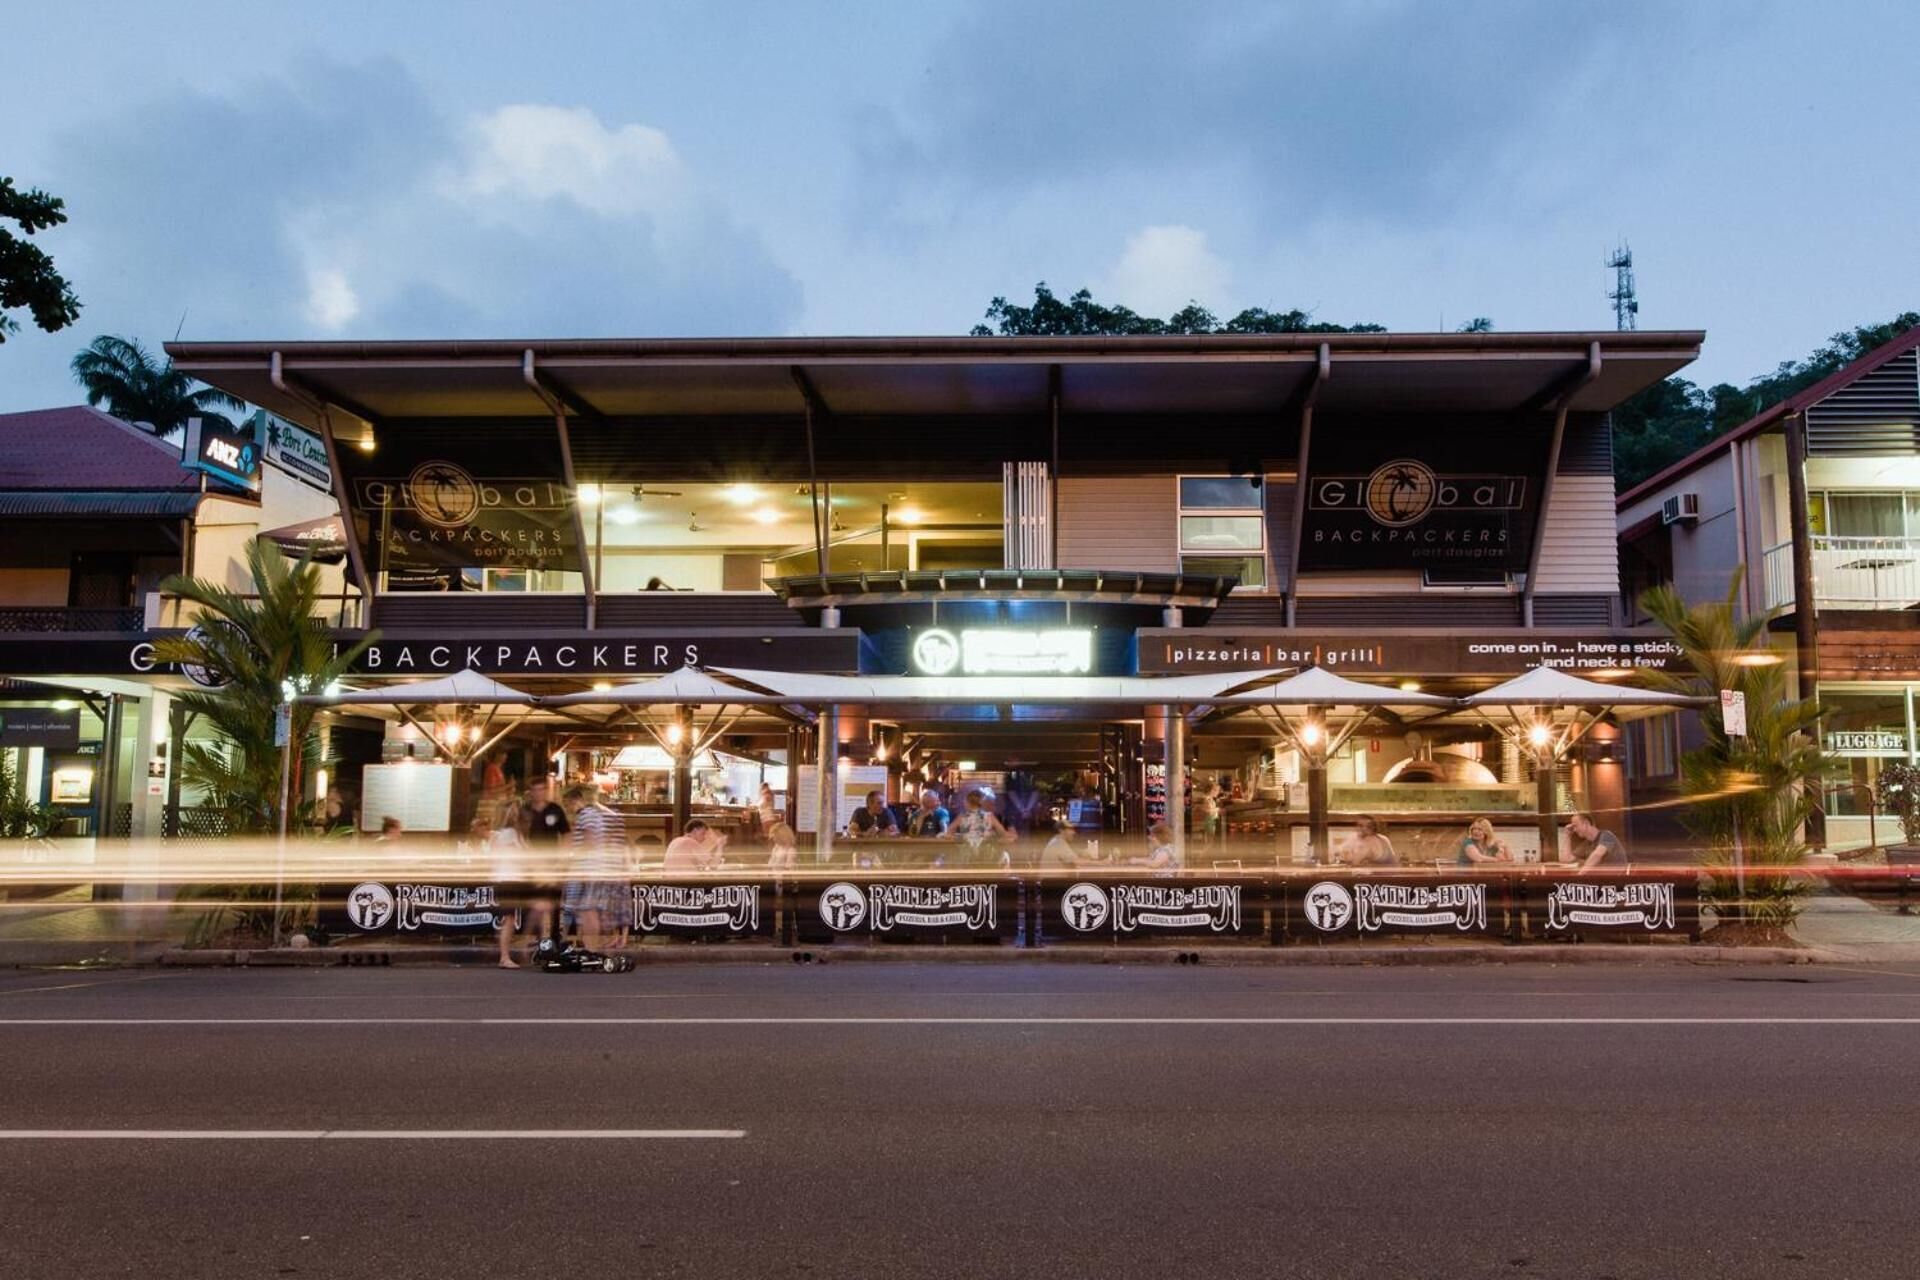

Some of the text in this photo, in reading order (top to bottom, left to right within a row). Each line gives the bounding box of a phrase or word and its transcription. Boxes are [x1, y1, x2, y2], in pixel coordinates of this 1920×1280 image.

[206, 438, 239, 469] ANZ
[374, 528, 562, 543] BACKPACKERS
[1315, 529, 1509, 542] BACKPACKERS
[367, 644, 699, 668] BACKPACKERS
[1174, 648, 1374, 665] pizzeria bar grill
[1469, 643, 1516, 654] come
[1518, 643, 1540, 654] on
[1542, 641, 1557, 653] in
[1577, 641, 1617, 654] have
[1620, 643, 1631, 653] a
[1633, 641, 1685, 656] sticky
[1577, 656, 1617, 668] neck
[1620, 659, 1631, 668] a
[1634, 656, 1666, 668] few
[77, 746, 95, 754] ANZ
[1836, 734, 1903, 748] LUGGAGE
[395, 884, 467, 930] RATTLE
[632, 885, 704, 930] RATTLE
[711, 885, 760, 930] HUM
[868, 884, 941, 930] RATTLE
[948, 884, 998, 930] HUM
[1110, 885, 1184, 931] RATTLE
[1191, 885, 1241, 931] HUM
[1353, 883, 1428, 930] RATTLE
[1436, 883, 1486, 930] HUM
[1623, 882, 1675, 929] HUM
